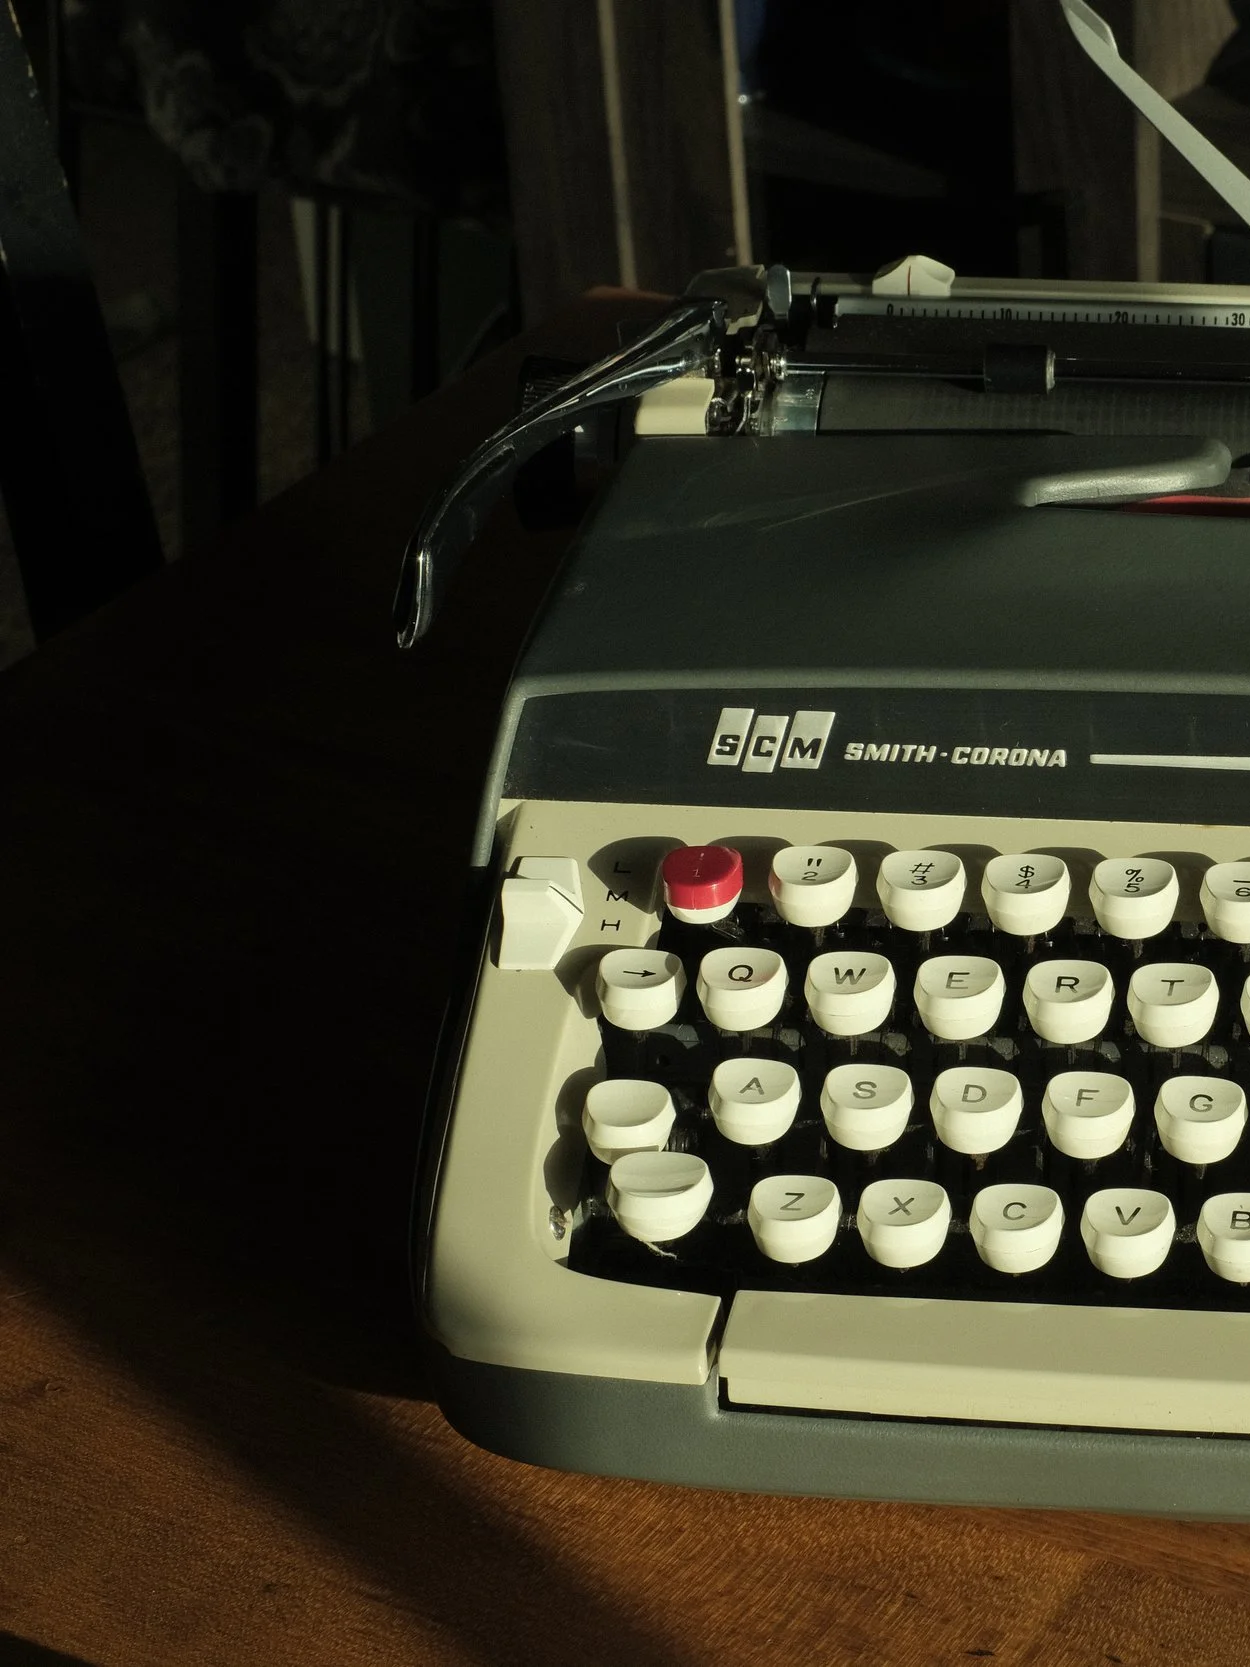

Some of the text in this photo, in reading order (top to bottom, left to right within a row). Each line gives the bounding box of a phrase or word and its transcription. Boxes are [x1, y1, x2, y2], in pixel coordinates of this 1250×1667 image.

[1000, 308, 1012, 320] 10
[1115, 311, 1128, 324] 20
[1231, 313, 1245, 326] 30
[715, 734, 822, 759] SCM
[613, 861, 632, 874] L
[801, 871, 818, 881] 2
[909, 862, 936, 875] #
[1018, 864, 1035, 879] $
[1125, 868, 1145, 883] %
[910, 875, 928, 887] 3
[1015, 878, 1032, 890] 4
[1124, 882, 1141, 894] 5
[605, 889, 629, 903] M
[600, 919, 621, 932] H
[727, 964, 754, 983] Q
[833, 967, 867, 985] W
[945, 971, 971, 990] E
[1055, 975, 1080, 994] R
[1160, 979, 1185, 996] T
[738, 1076, 765, 1096] A
[852, 1080, 878, 1100] S
[961, 1083, 988, 1104] D
[1075, 1088, 1100, 1107] F
[1189, 1093, 1214, 1113] G
[779, 1192, 806, 1211] Z
[887, 1196, 915, 1217] X
[1002, 1201, 1028, 1221] C
[1114, 1205, 1142, 1226] V
